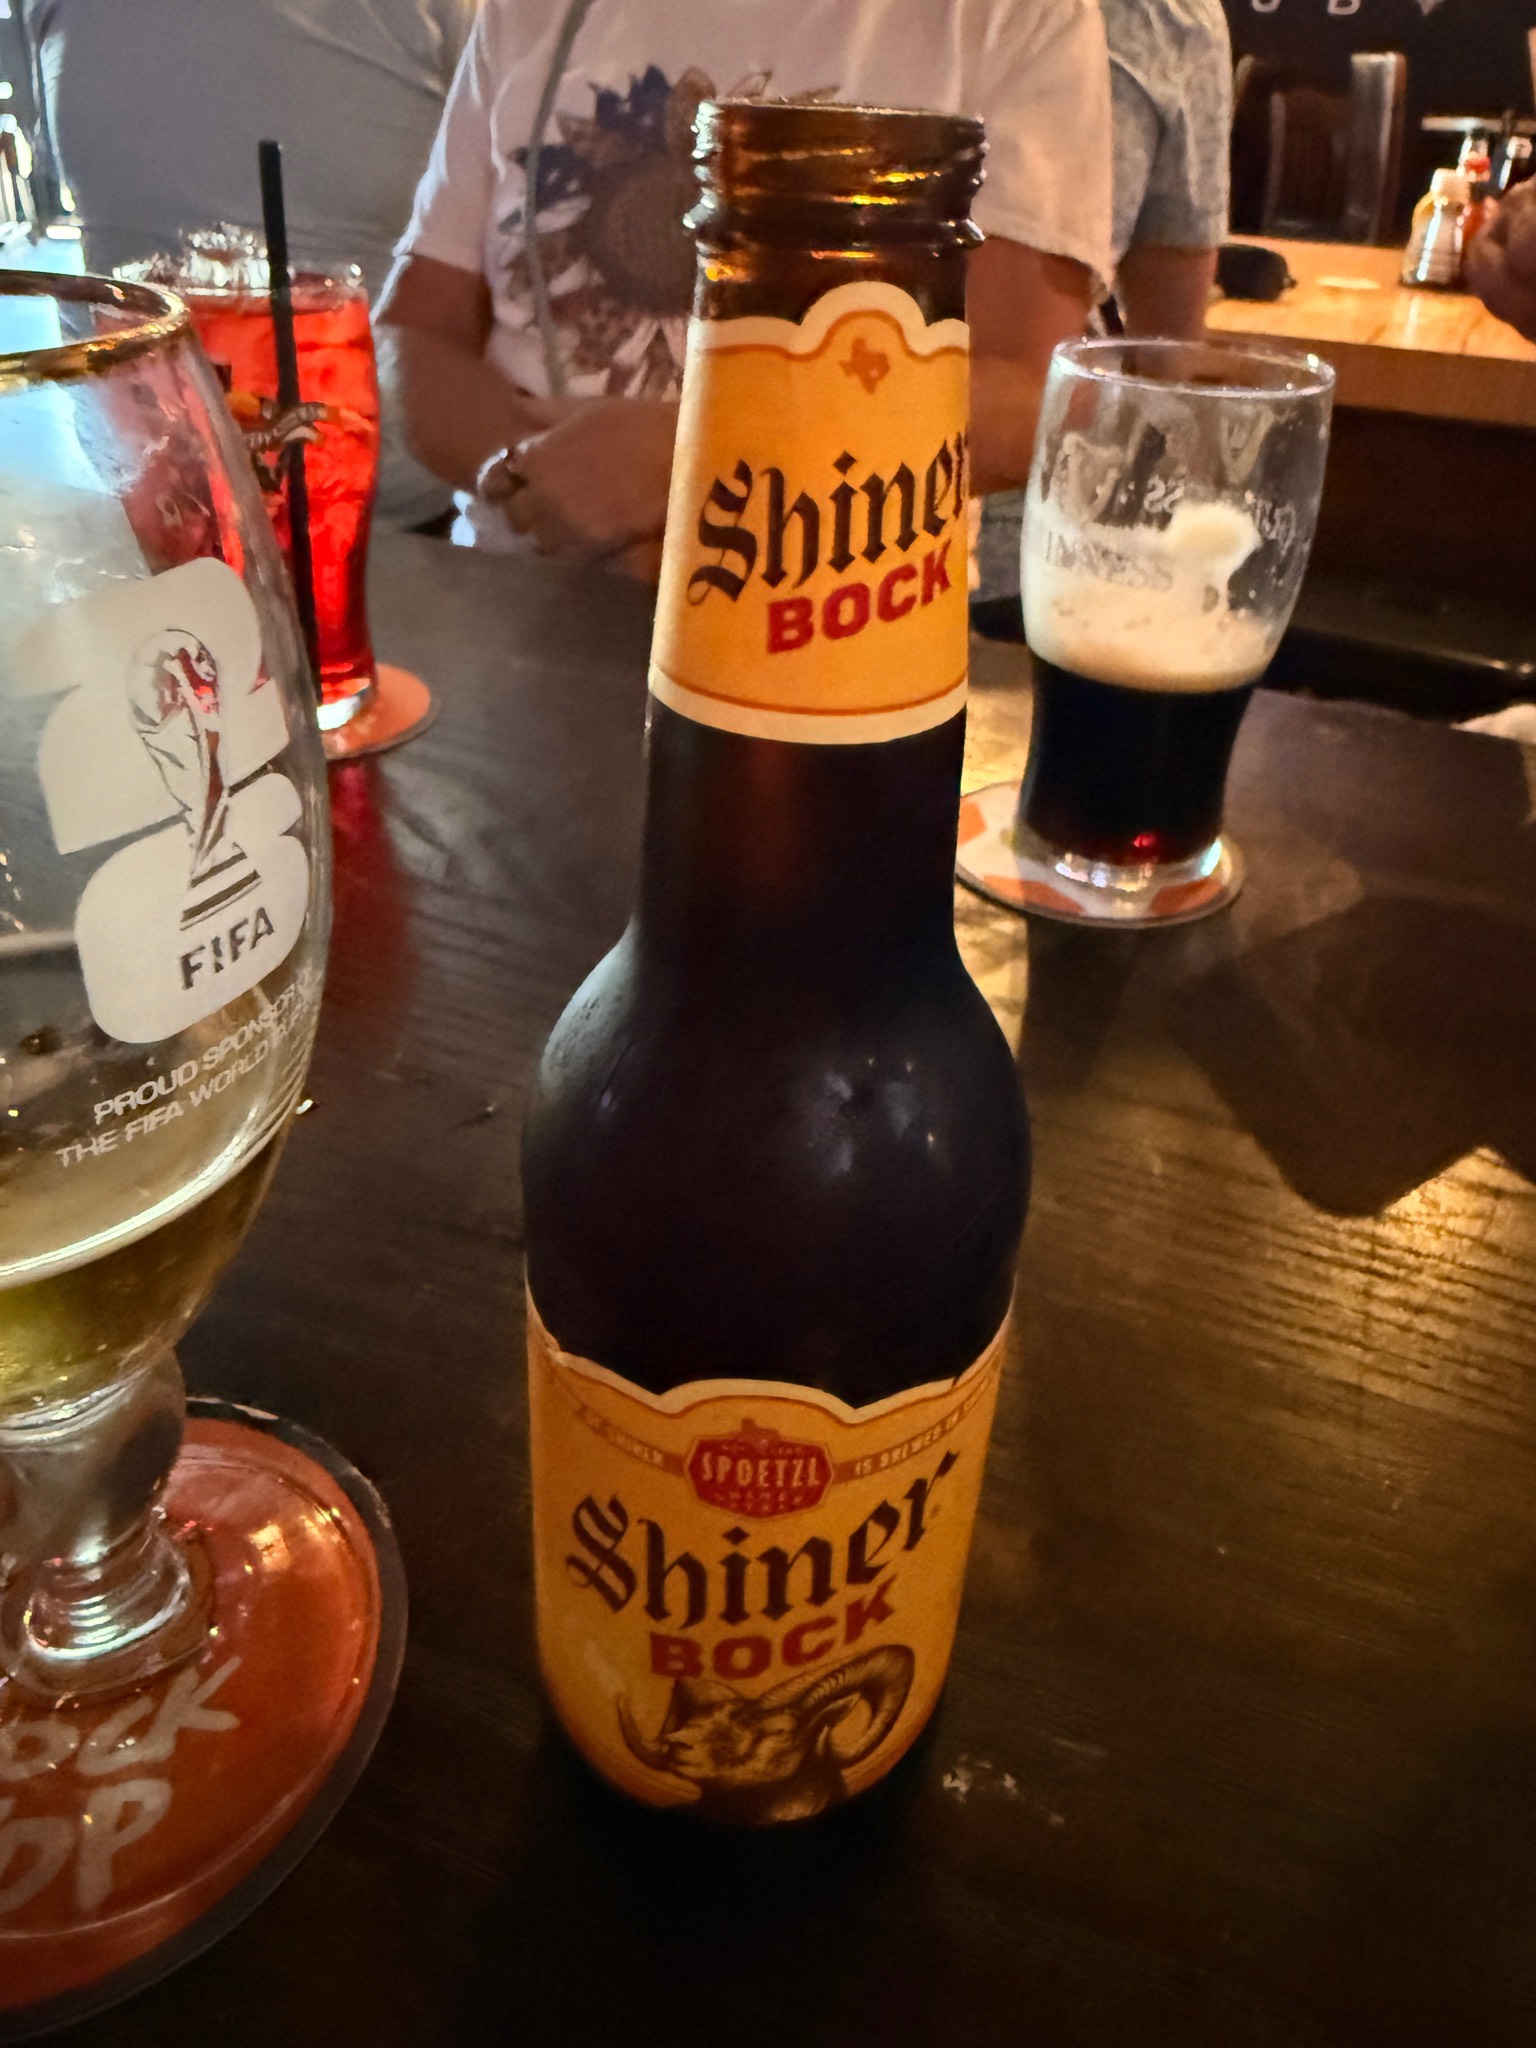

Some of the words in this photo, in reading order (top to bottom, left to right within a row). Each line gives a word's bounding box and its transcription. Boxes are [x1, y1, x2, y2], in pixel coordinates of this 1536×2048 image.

[687, 430, 969, 607] Shiner
[766, 538, 952, 655] BOCK
[179, 905, 274, 992] FIFA
[55, 1128, 119, 1168] THE
[124, 1100, 184, 1143] FIFA
[189, 1039, 270, 1107] WORLD
[93, 1060, 199, 1125] PROUD
[701, 1451, 821, 1488] SPOETZL
[565, 1449, 959, 1630] Shiner
[650, 1574, 897, 1680] BOCK
